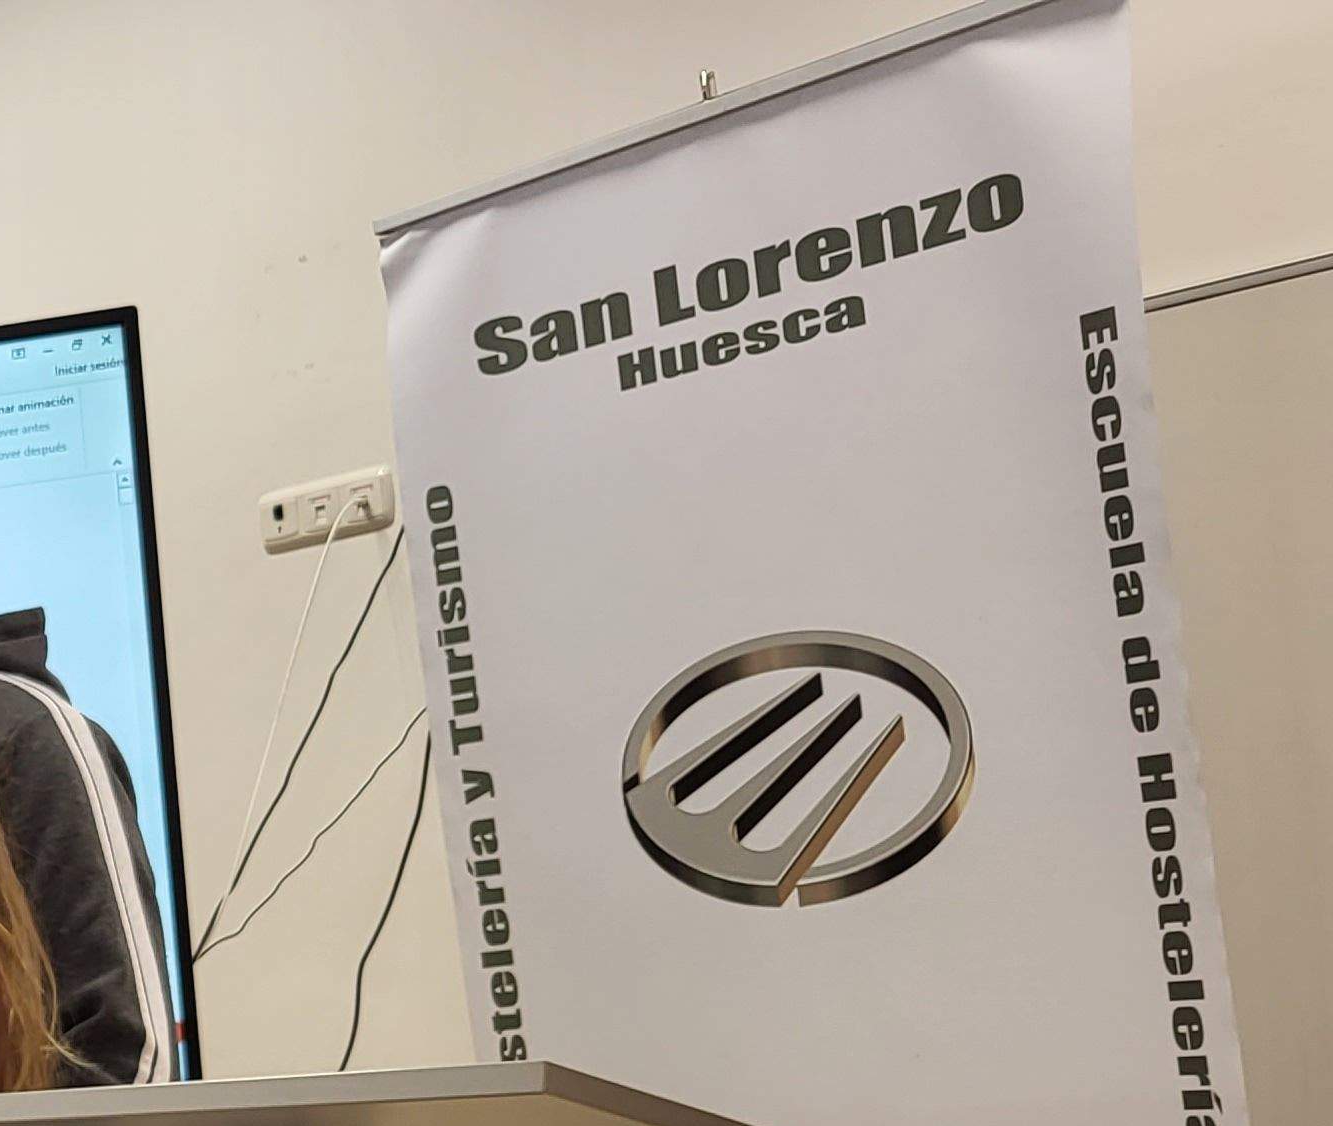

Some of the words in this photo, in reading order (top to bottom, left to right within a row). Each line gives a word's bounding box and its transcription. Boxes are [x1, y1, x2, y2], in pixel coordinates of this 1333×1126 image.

[474, 292, 633, 375] San
[653, 173, 1024, 326] Lorenzo
[54, 362, 88, 377] Iniciar
[617, 295, 867, 391] Huesca
[17, 394, 74, 412] animación
[21, 421, 51, 434] antes
[24, 441, 68, 458] después
[1079, 305, 1146, 618] Escuela
[1121, 636, 1161, 733] de
[424, 484, 485, 756] Turismo
[461, 769, 495, 805] y
[469, 817, 528, 1062] stelería
